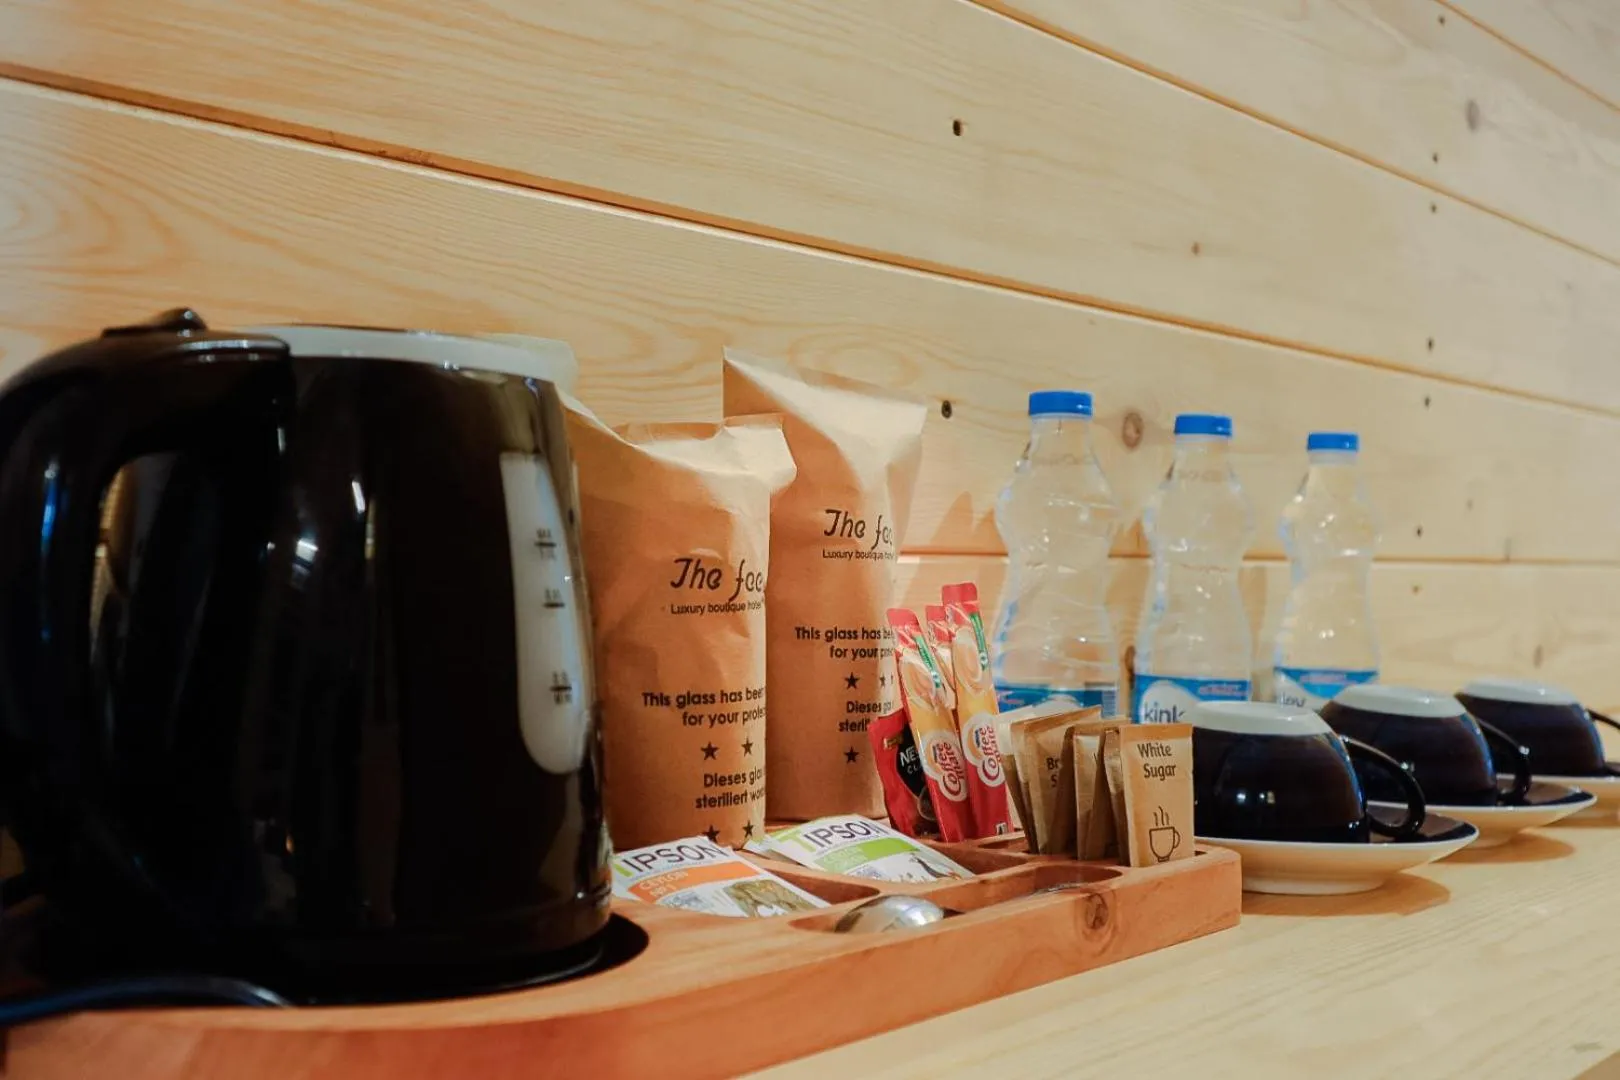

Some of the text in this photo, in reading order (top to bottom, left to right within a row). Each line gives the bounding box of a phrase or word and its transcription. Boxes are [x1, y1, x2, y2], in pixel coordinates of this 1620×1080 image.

[824, 509, 866, 538] The
[822, 549, 853, 561] Luxury
[670, 558, 722, 590] The
[671, 603, 705, 616] Luxury
[708, 601, 746, 615] boutique
[795, 626, 821, 640] This
[825, 626, 859, 643] glass
[861, 627, 881, 640] has
[830, 645, 849, 659] for
[851, 647, 879, 661] your
[642, 691, 671, 707] This
[676, 690, 716, 709] glass
[720, 689, 742, 704] has
[682, 711, 703, 726] for
[708, 710, 740, 729] your
[1144, 701, 1187, 724] kinl
[1137, 742, 1173, 758] White
[703, 766, 763, 788] Dieses gla
[1143, 763, 1177, 782] Sugar
